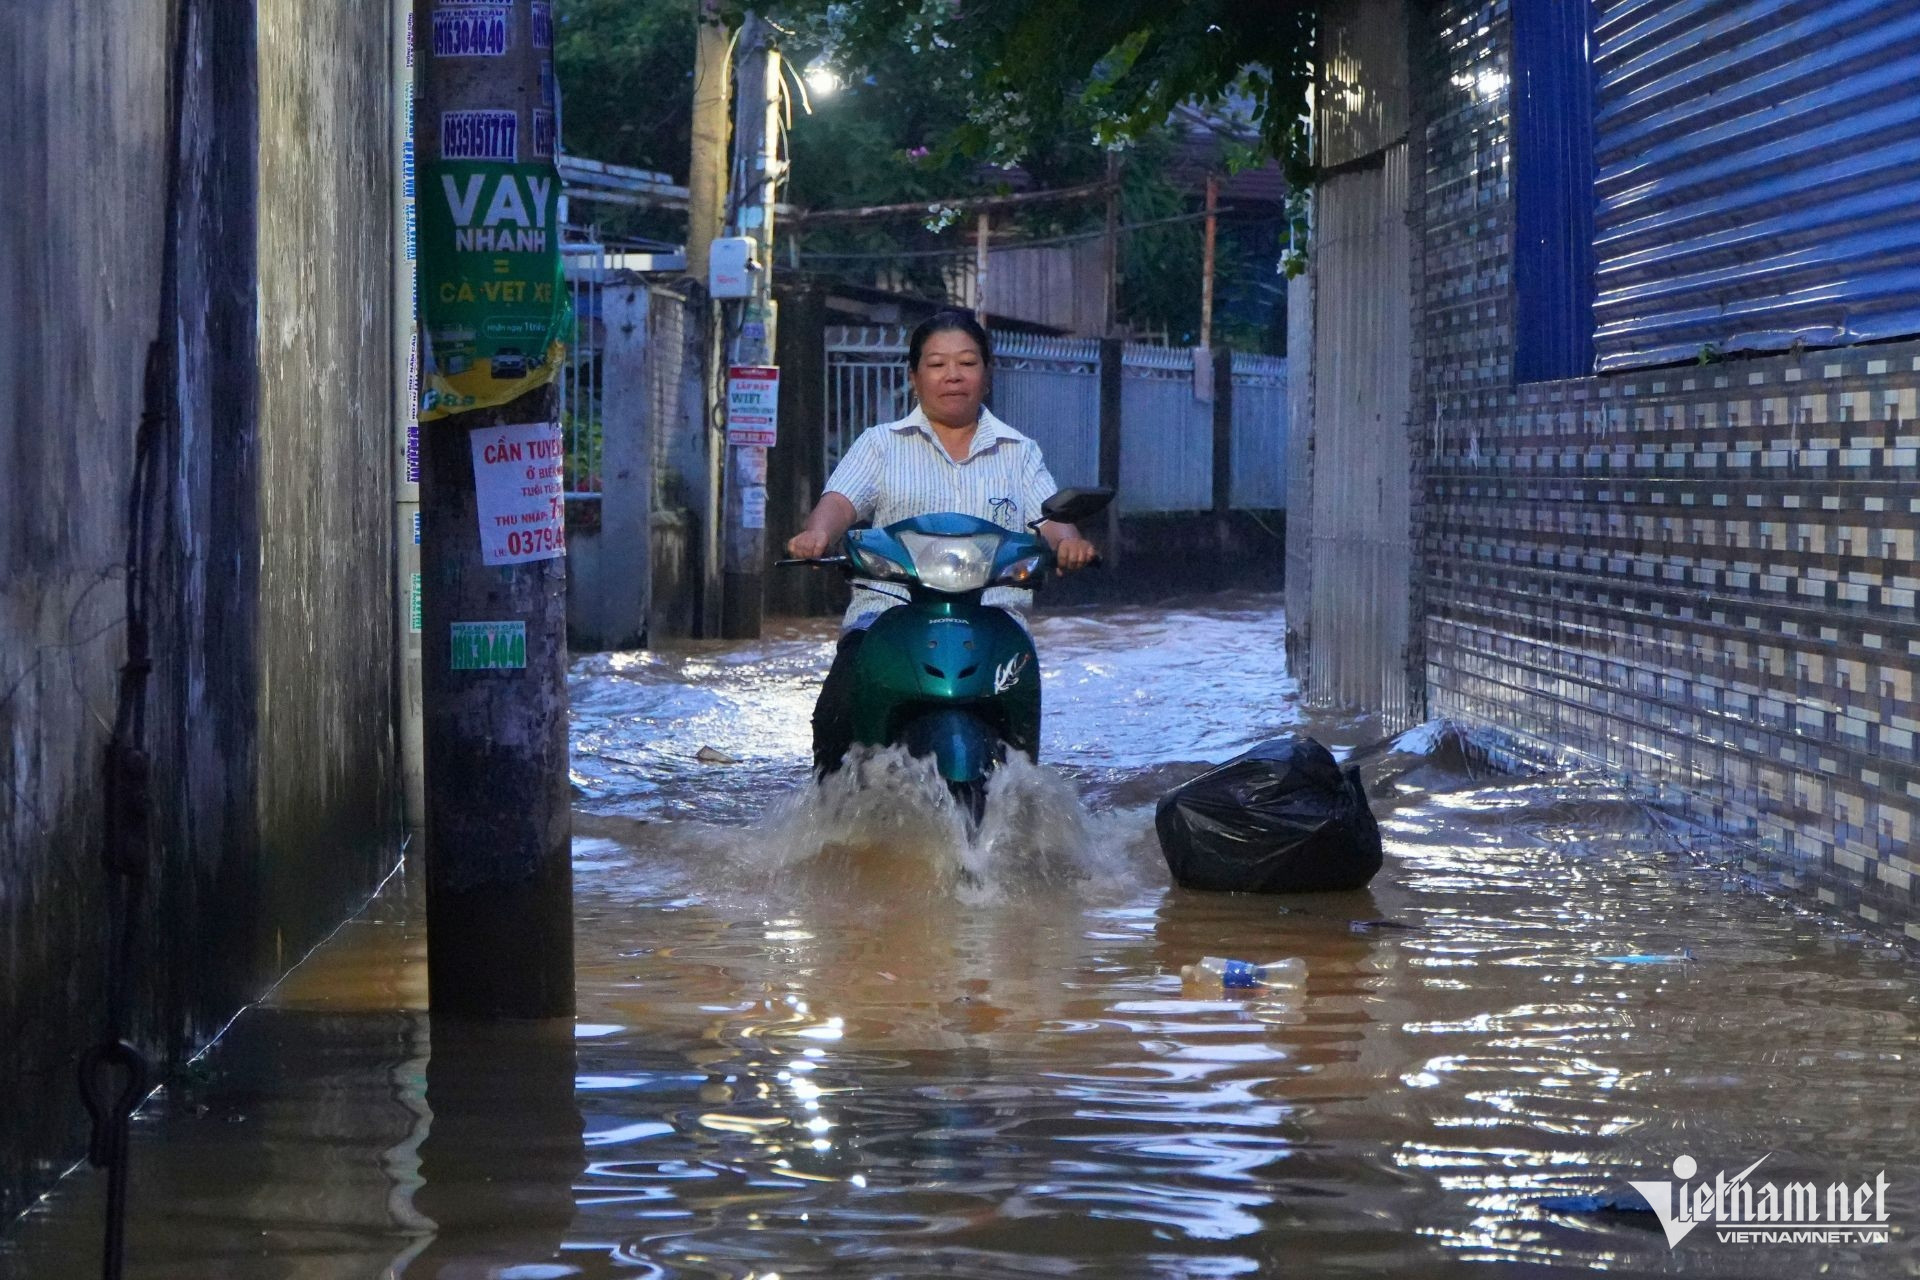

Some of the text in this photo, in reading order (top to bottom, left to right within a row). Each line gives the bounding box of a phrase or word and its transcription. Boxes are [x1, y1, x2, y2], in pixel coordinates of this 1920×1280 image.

[440, 173, 551, 228] VAY
[455, 228, 546, 253] NHANH
[440, 276, 474, 303] CÀ
[484, 435, 522, 464] CẦN
[496, 515, 517, 527] THU
